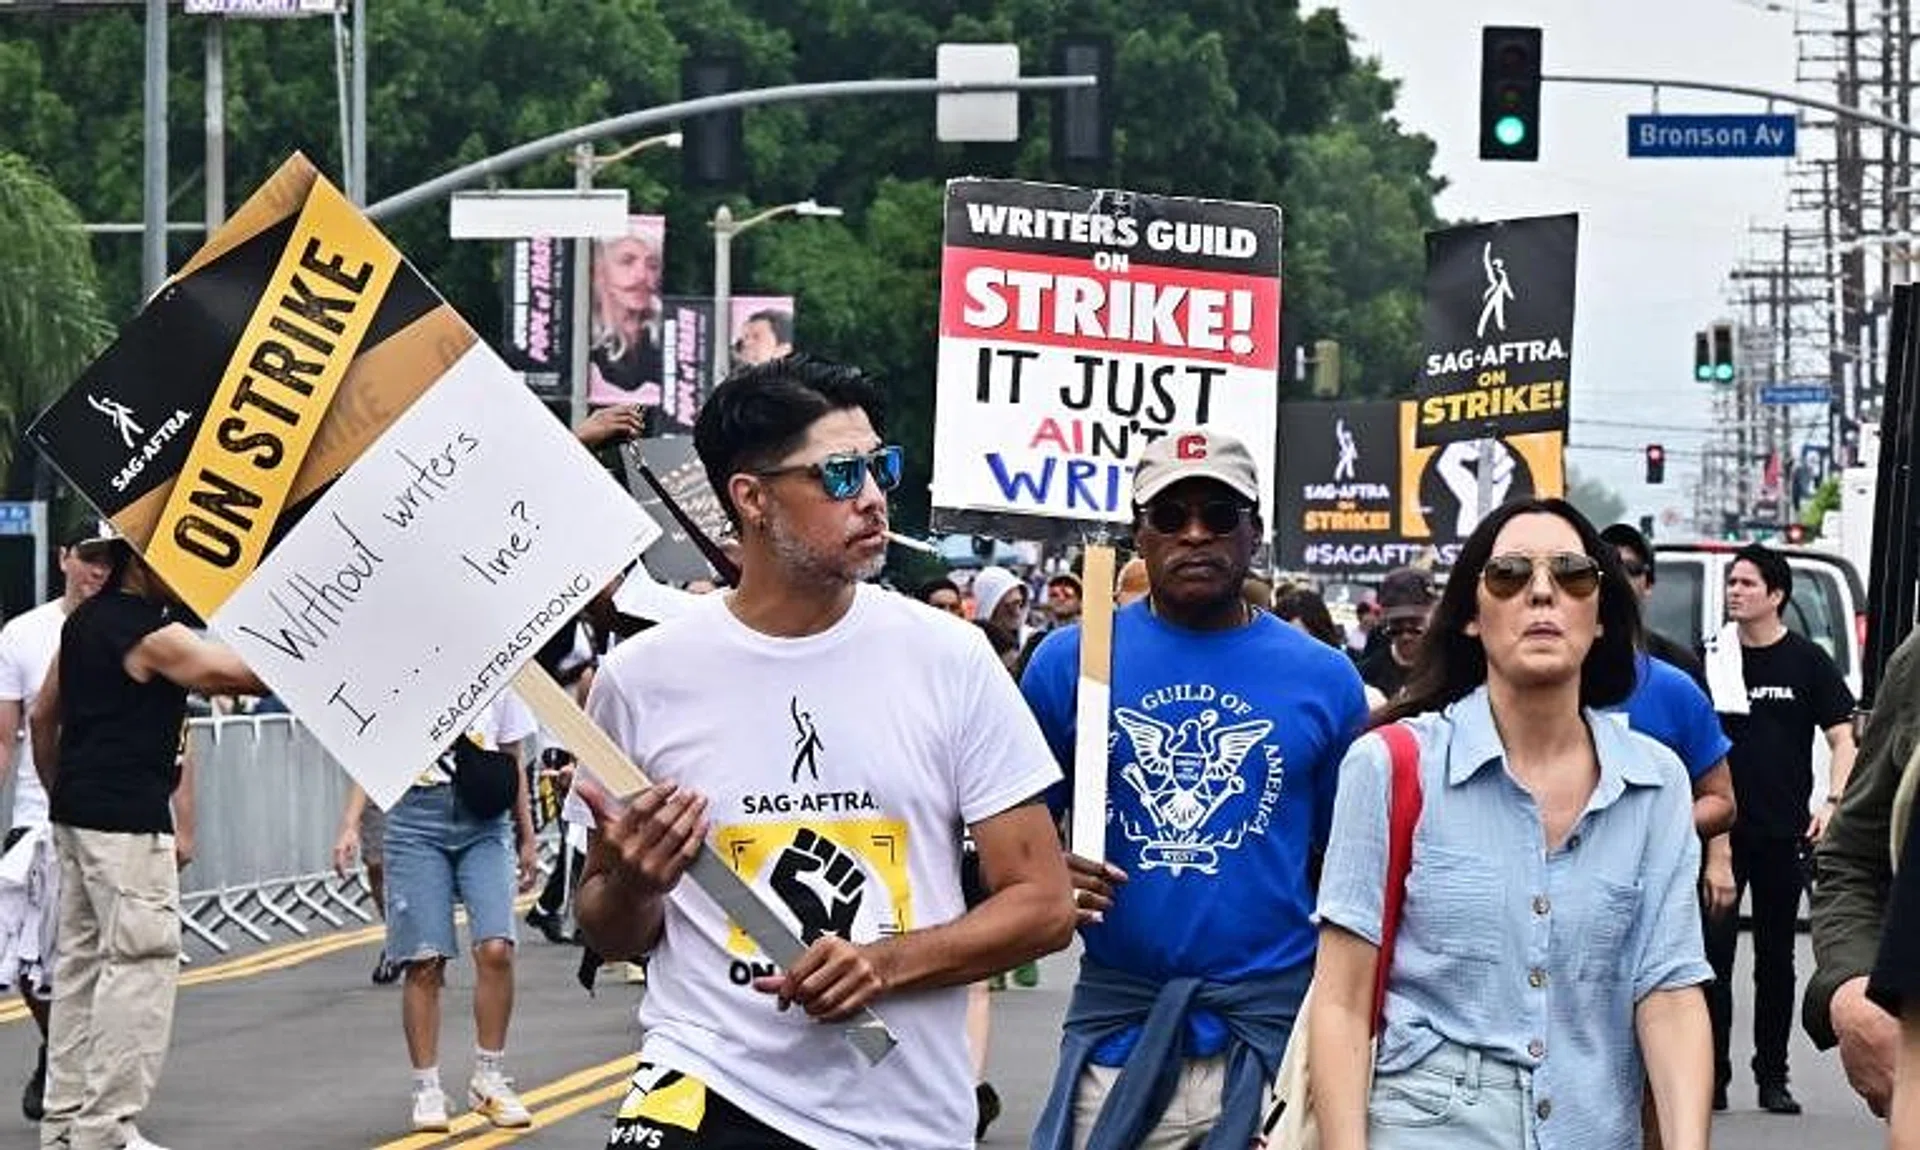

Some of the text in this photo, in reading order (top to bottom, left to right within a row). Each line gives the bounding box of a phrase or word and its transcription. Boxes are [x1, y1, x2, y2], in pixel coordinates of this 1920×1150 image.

[1640, 124, 1784, 146] Bronson Av
[967, 203, 1257, 258] WRITERS GUILD
[1094, 251, 1129, 272] ON
[963, 266, 1256, 355] STRIKE!
[217, 237, 374, 469] STRIKE
[976, 347, 1227, 425] IT JUST
[1477, 370, 1506, 387] ON
[1422, 381, 1564, 425] STRIKE!
[1177, 434, 1208, 459] C
[985, 452, 1133, 512] WRI
[173, 469, 263, 569] ON
[239, 432, 478, 661] Without writers
[460, 500, 542, 586] line?
[1305, 544, 1463, 565] #SAGAFTAS
[429, 573, 592, 742] #SAGAFTRASTRONG
[1142, 684, 1285, 835] GUILD OF AMERICA
